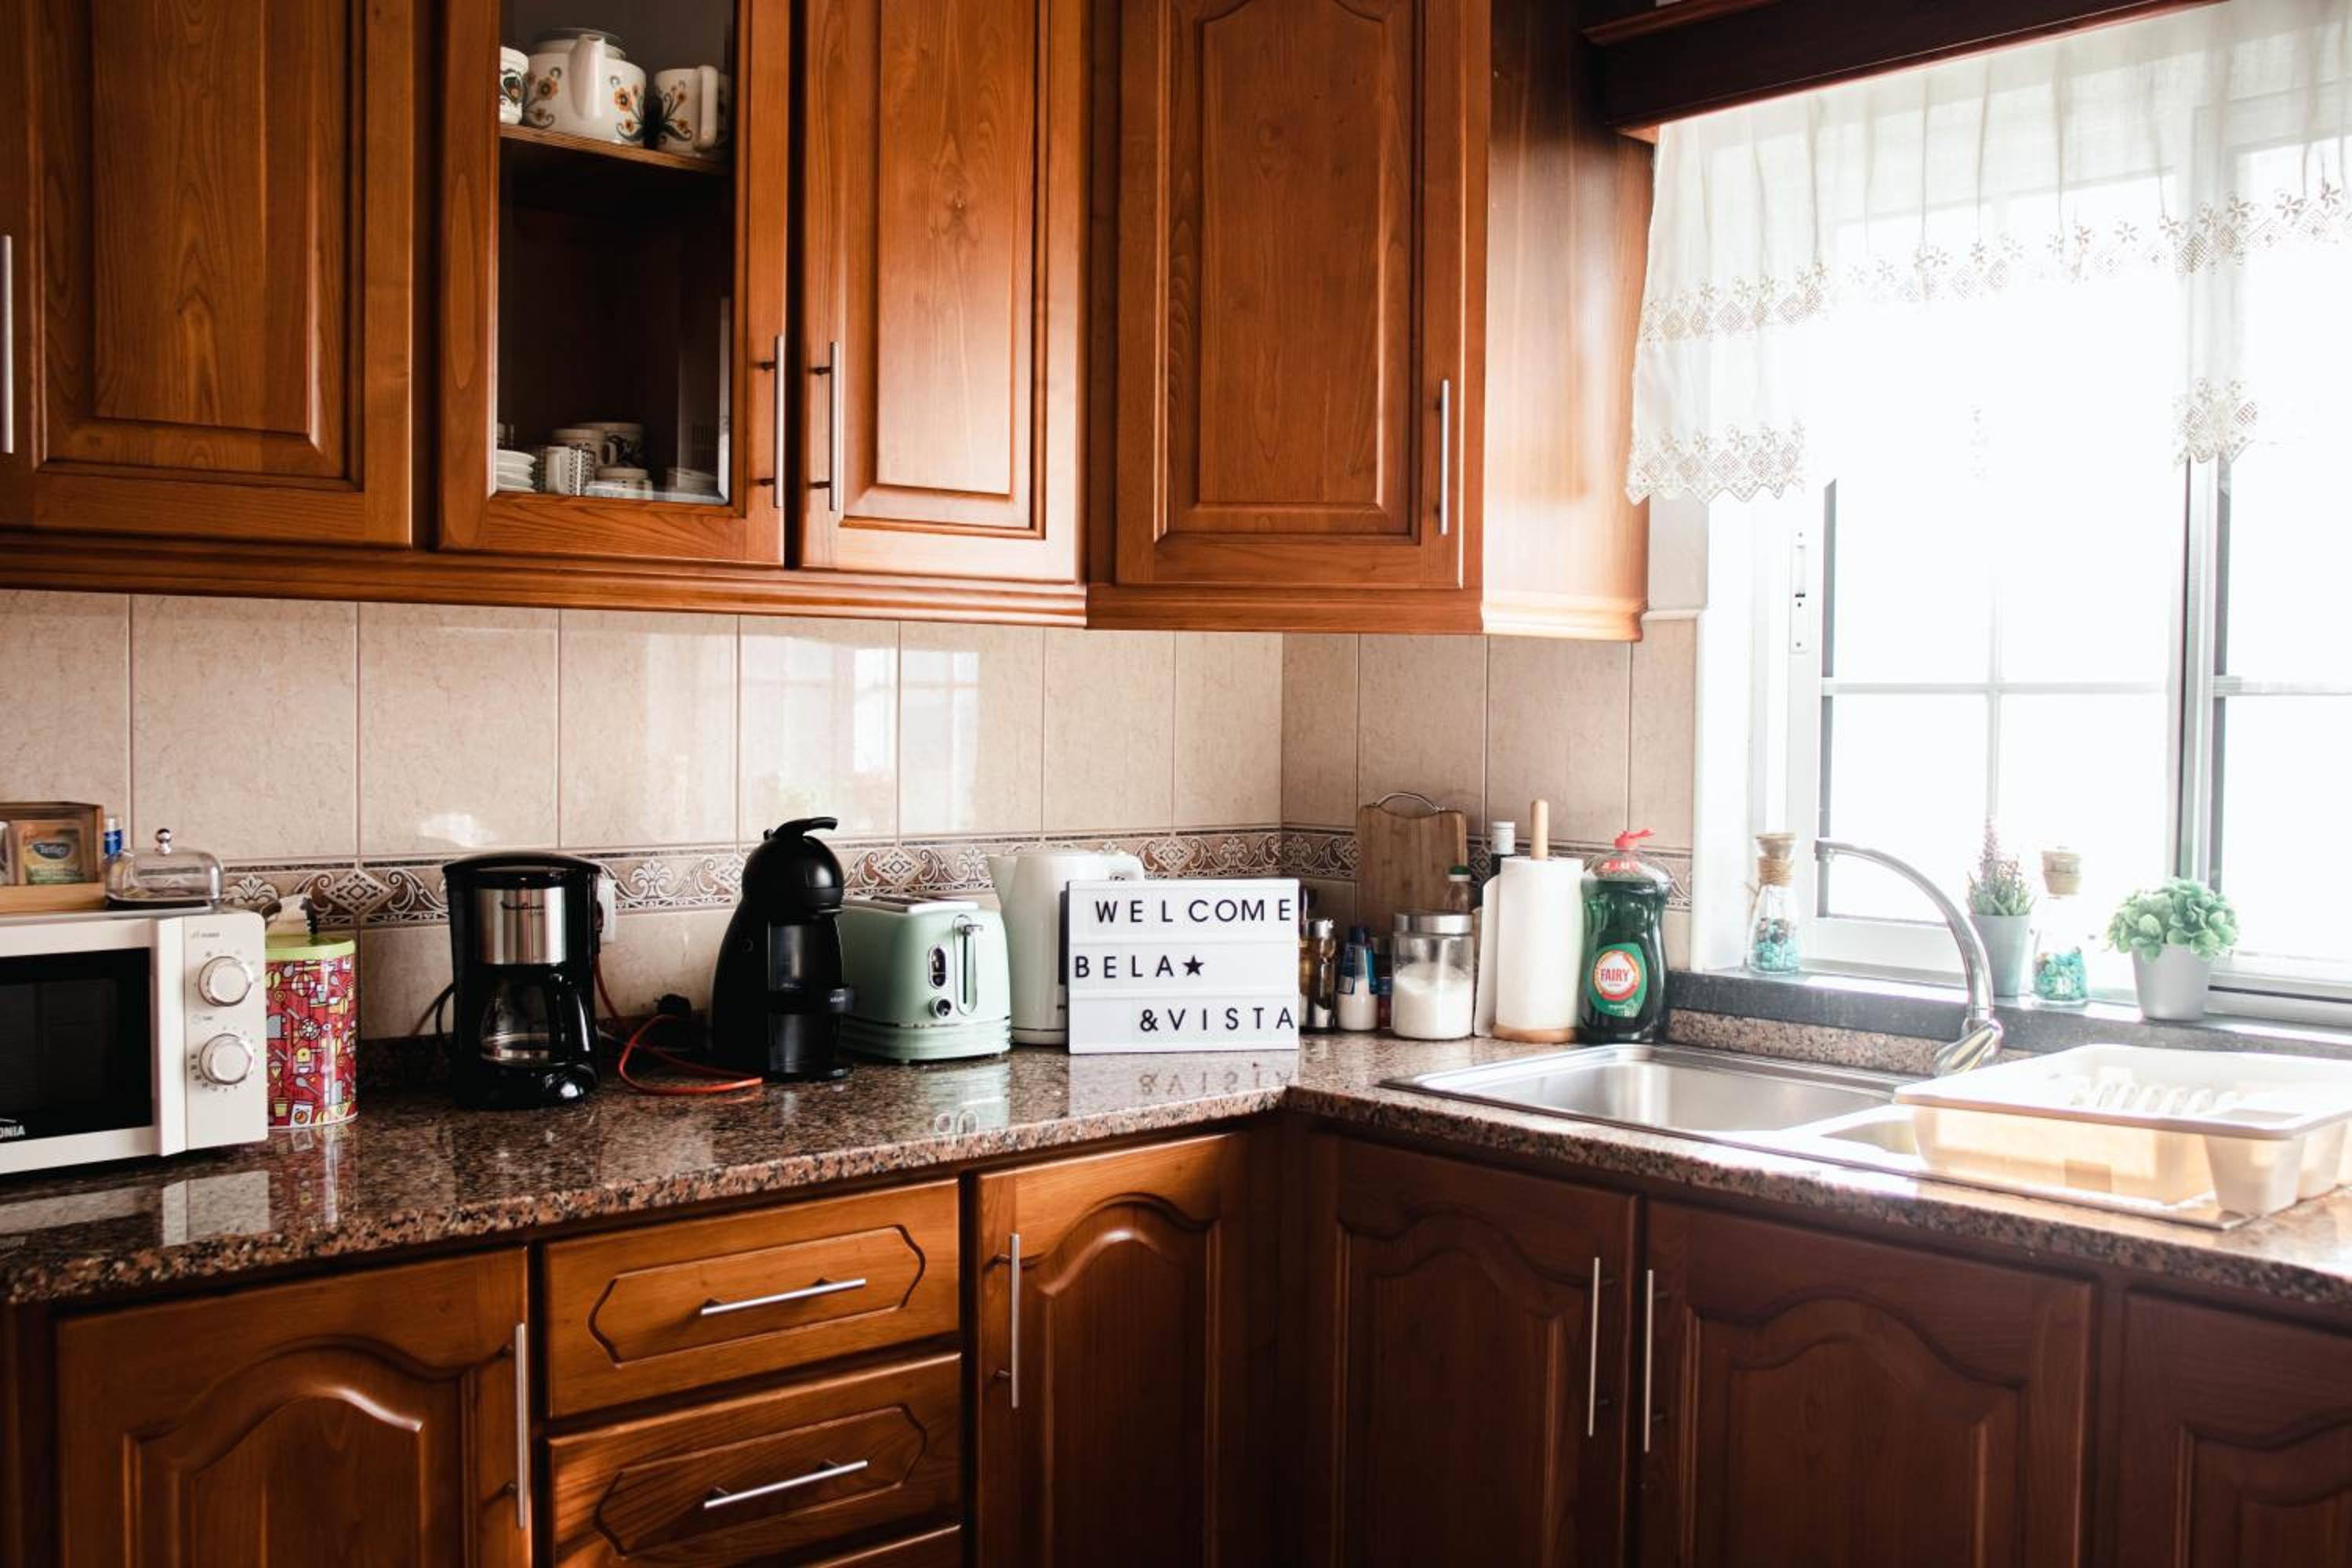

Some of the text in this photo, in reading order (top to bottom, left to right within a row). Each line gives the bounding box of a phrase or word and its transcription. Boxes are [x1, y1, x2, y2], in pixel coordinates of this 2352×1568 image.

[1094, 898, 1292, 924] WELCOME
[1074, 954, 1174, 979] BELA
[1600, 968, 1630, 982] FAIRY
[1139, 1007, 1295, 1033] &VISTA
